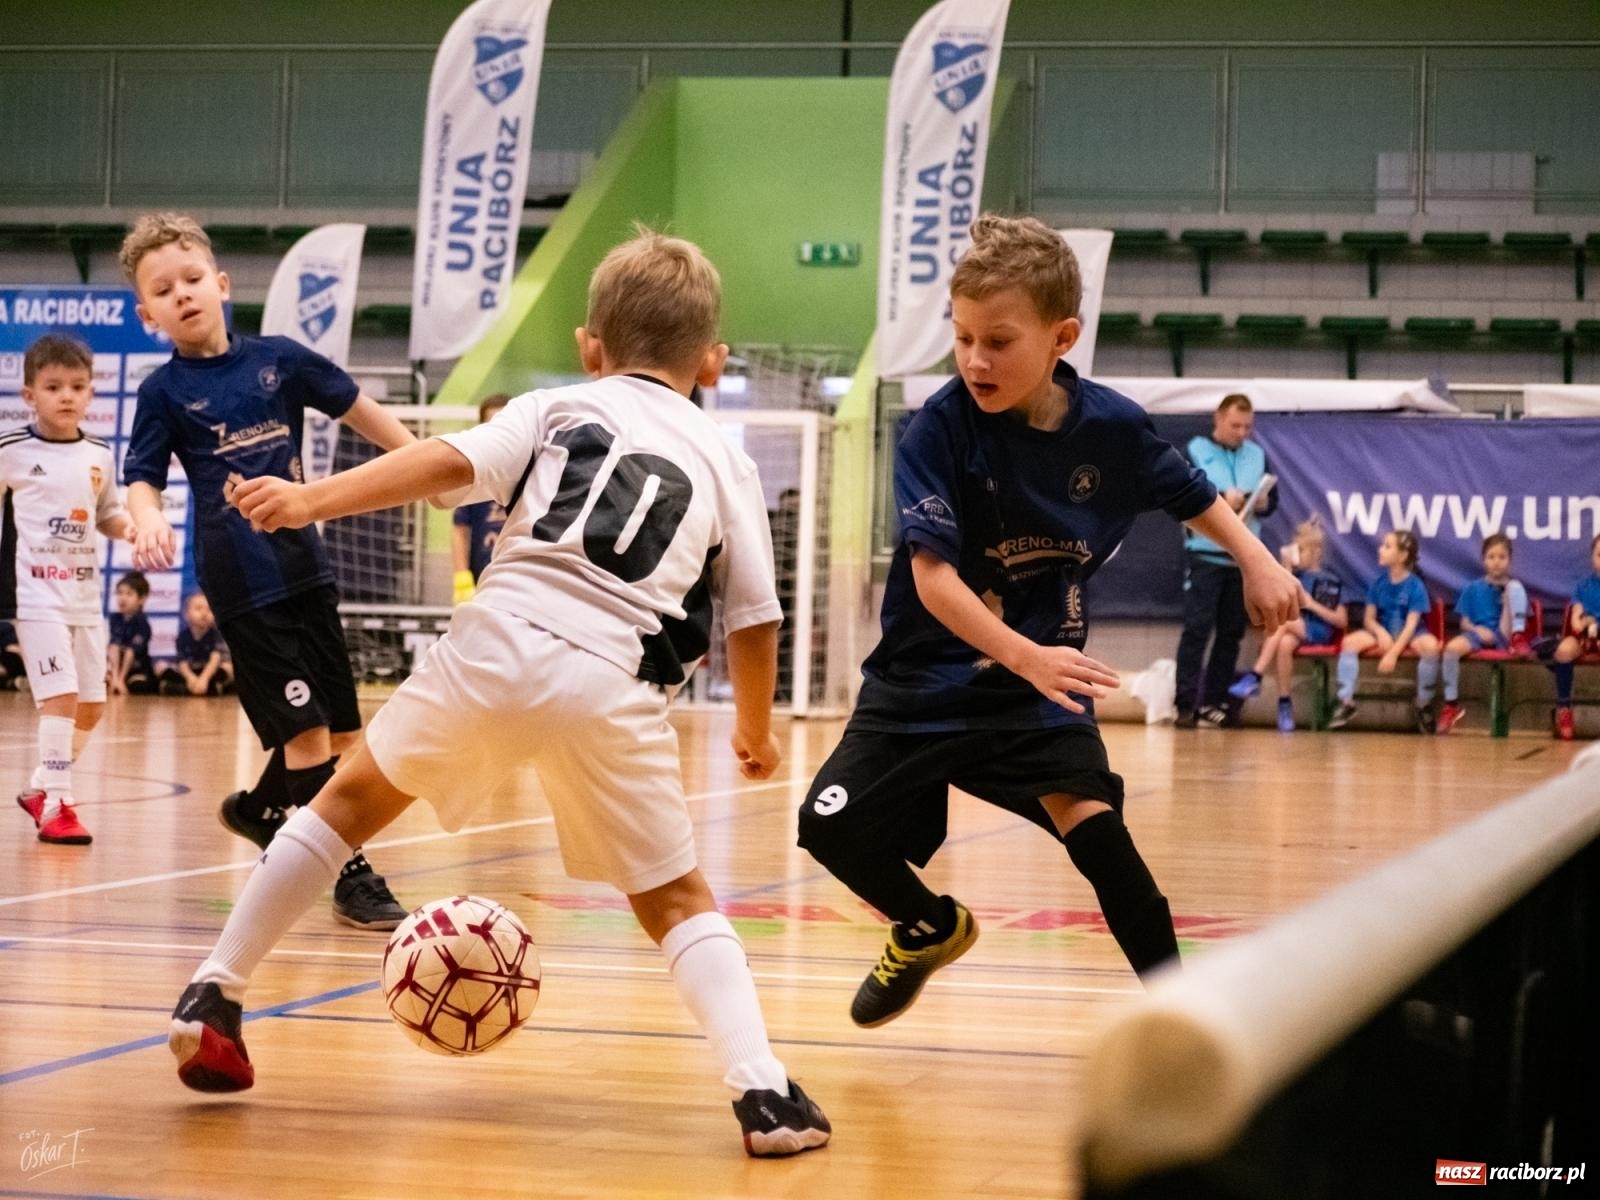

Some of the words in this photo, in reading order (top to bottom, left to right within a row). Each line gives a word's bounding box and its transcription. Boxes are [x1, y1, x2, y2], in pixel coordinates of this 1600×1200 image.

[445, 152, 487, 272] UNIA
[909, 162, 950, 285] UNIA
[14, 293, 125, 326] RACIBÓRZ
[48, 516, 86, 540] Foxy
[532, 422, 693, 583] 10
[1326, 490, 1600, 541] www.un
